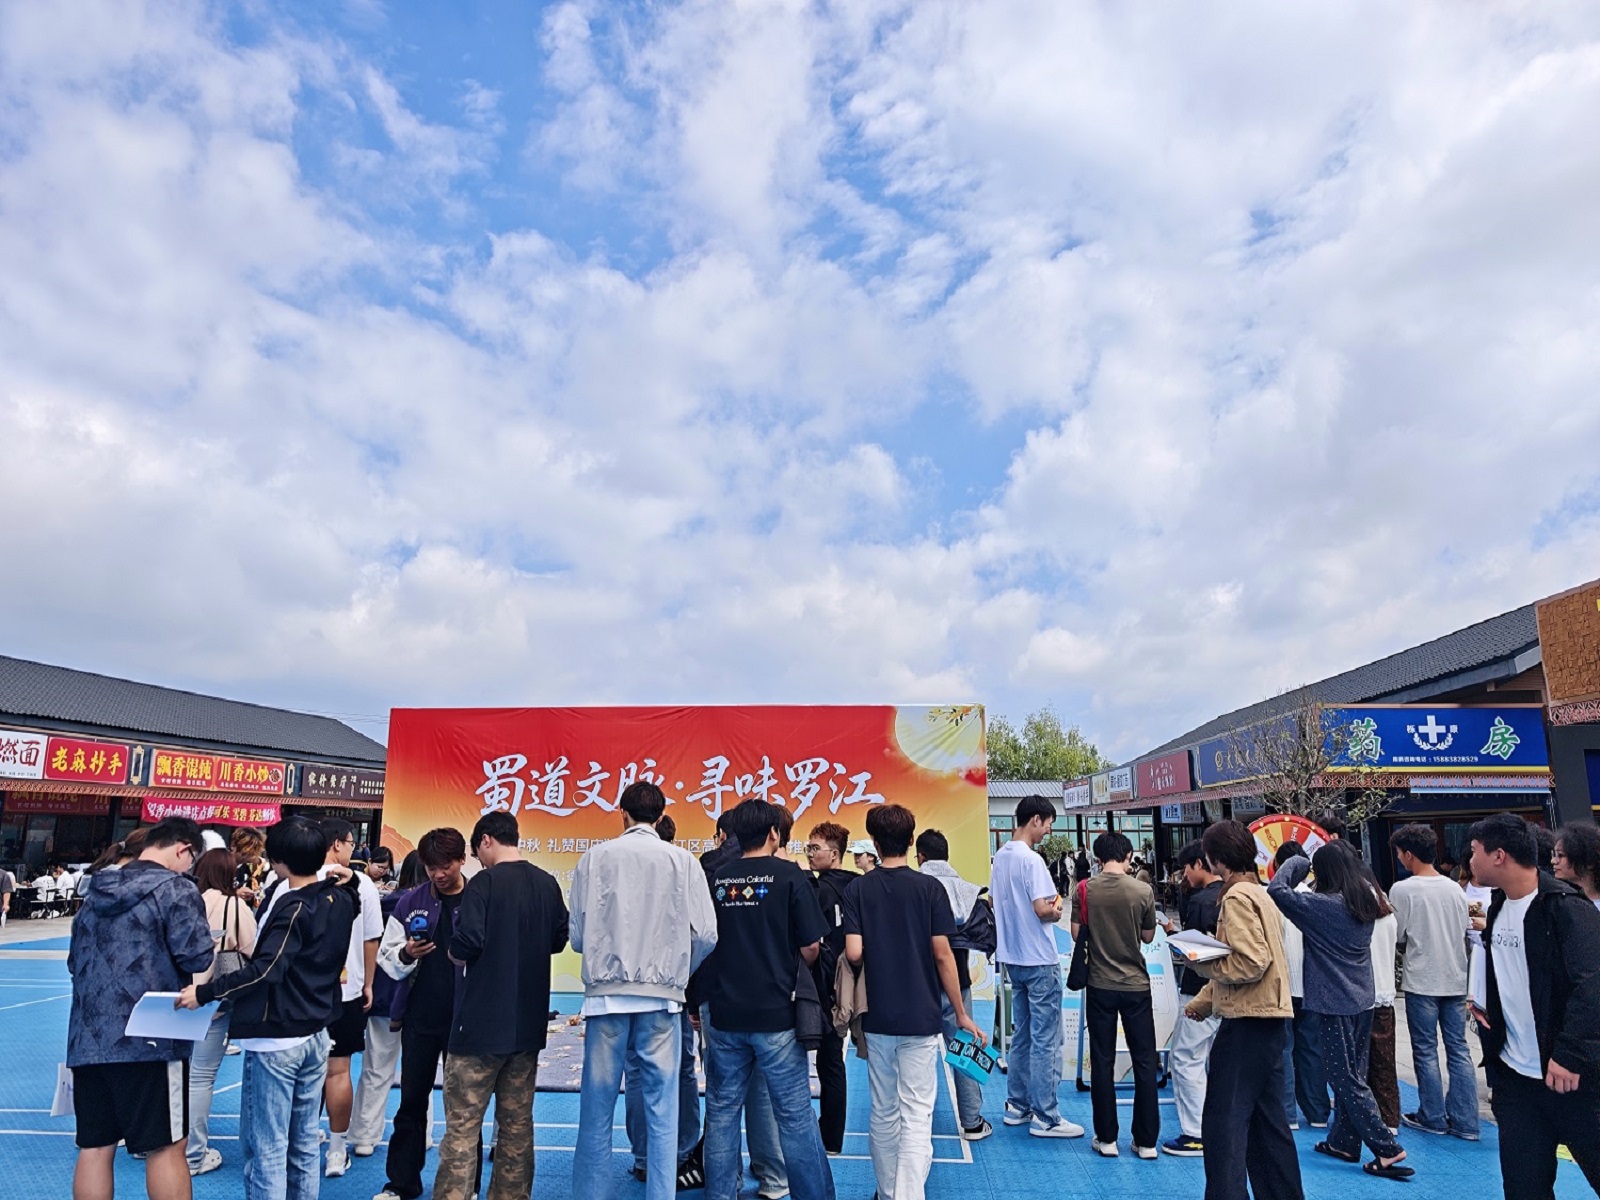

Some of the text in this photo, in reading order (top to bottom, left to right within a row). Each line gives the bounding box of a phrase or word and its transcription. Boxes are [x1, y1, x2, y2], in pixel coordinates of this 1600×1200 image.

[1347, 715, 1520, 763] 药 房
[52, 746, 123, 776] 老麻抄手
[156, 755, 212, 780] 飘香馄饨
[218, 761, 270, 784] 川香小炒
[746, 874, 774, 884] Colorful
